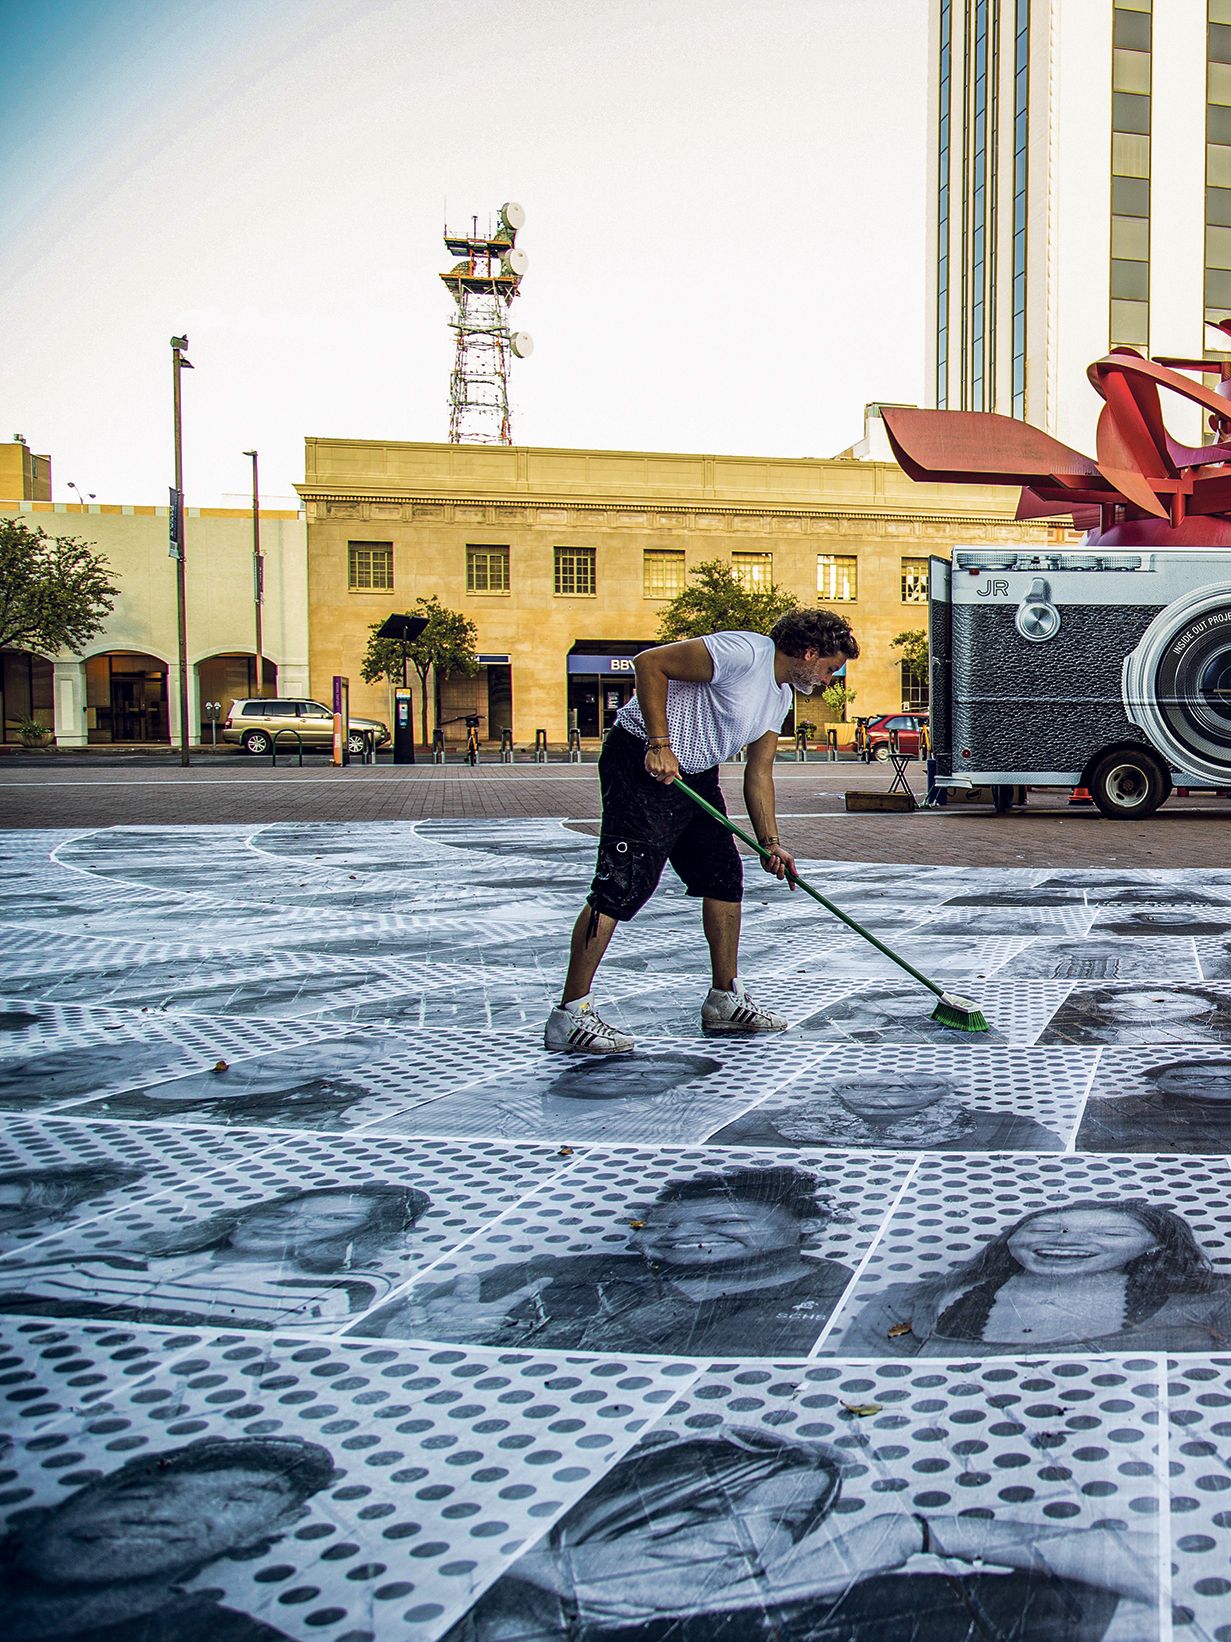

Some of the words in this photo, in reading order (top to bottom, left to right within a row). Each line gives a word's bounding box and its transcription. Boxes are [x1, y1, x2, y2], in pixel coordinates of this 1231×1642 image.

[976, 579, 1009, 596] JR
[1172, 631, 1194, 655] INSIDE
[1191, 620, 1208, 635] OUT
[776, 1312, 826, 1320] SCHS
